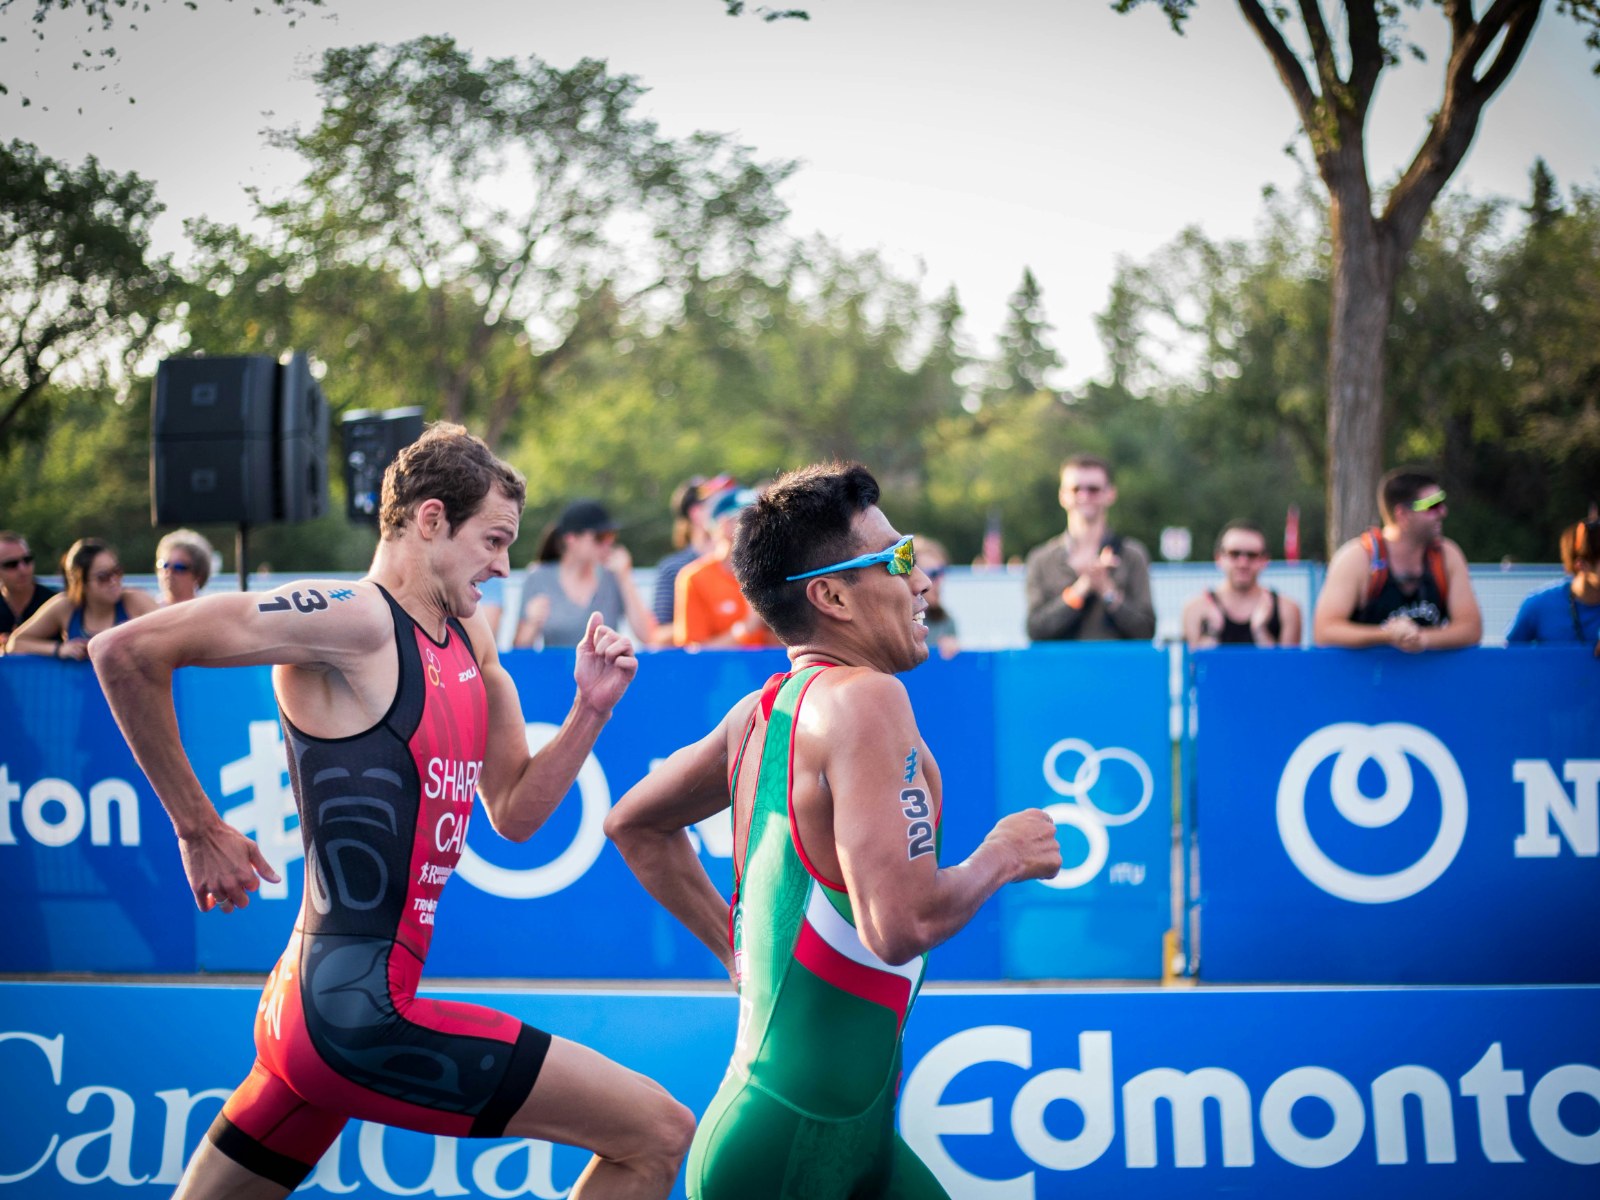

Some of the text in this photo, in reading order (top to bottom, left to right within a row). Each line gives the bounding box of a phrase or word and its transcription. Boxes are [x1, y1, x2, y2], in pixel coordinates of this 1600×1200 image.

[458, 665, 477, 683] 2XU
[435, 812, 470, 854] CA
[900, 787, 935, 861] 32
[899, 1024, 1600, 1200] Edmonto
